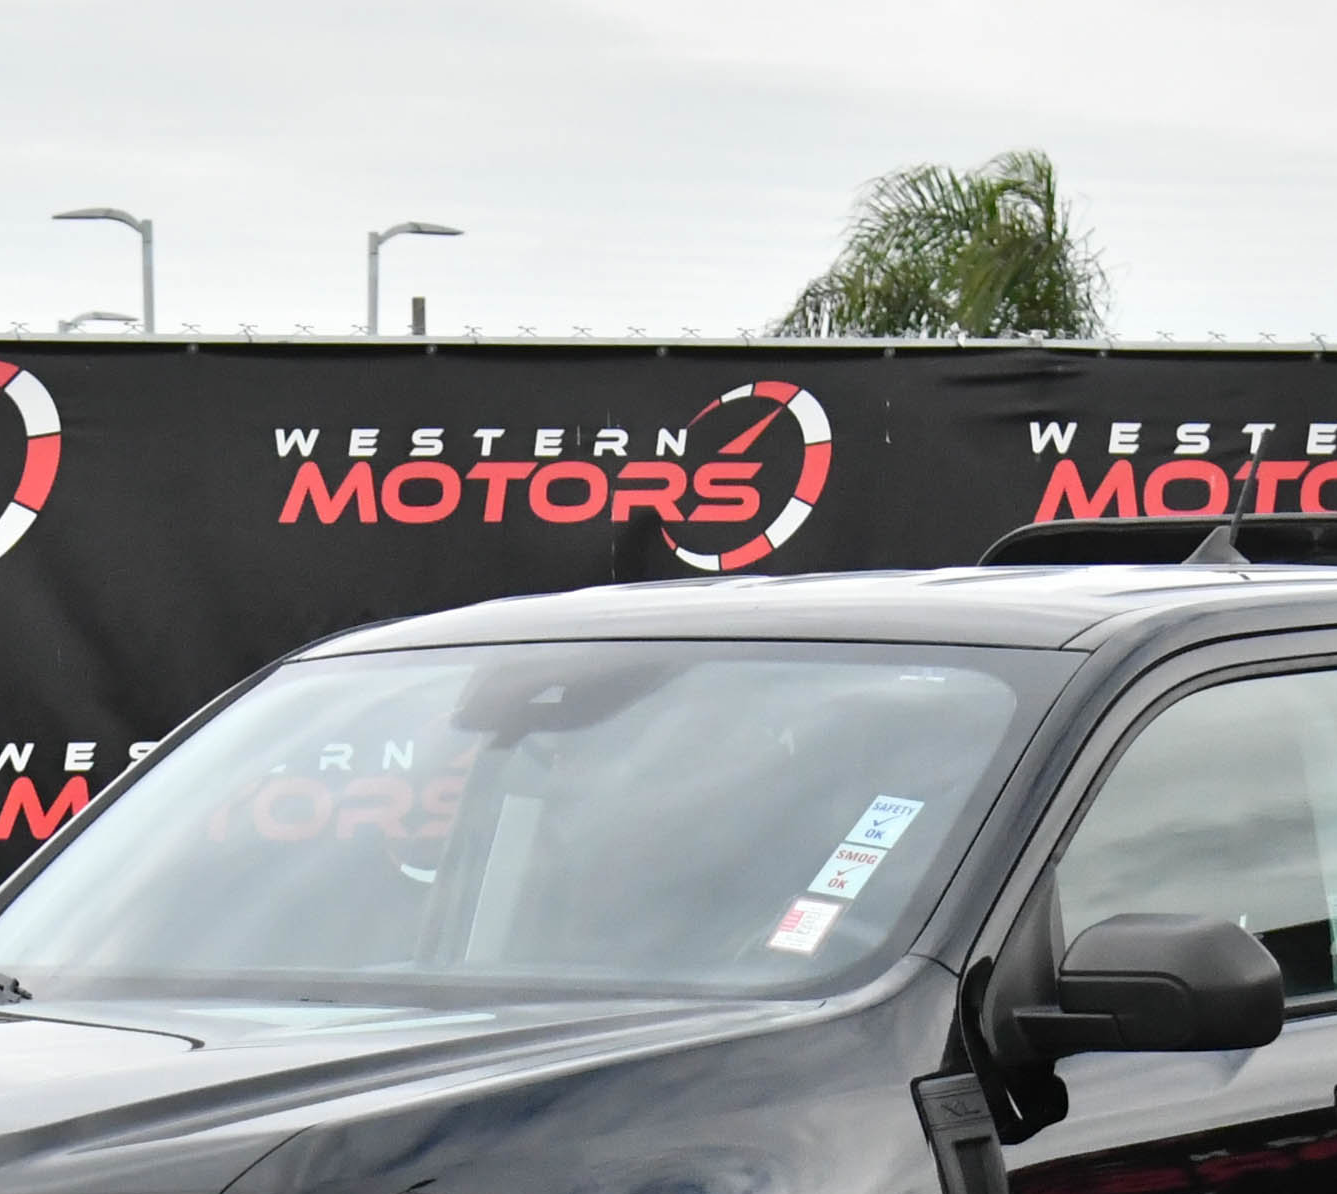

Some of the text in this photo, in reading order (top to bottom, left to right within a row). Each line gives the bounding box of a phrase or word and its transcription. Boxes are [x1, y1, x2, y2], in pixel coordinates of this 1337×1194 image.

[275, 427, 688, 457] WESTERN
[278, 460, 763, 525] MOTORS
[872, 801, 915, 817] SAFETY
[864, 828, 886, 841] OK
[835, 849, 879, 865] SMOG
[828, 877, 849, 891] OK
